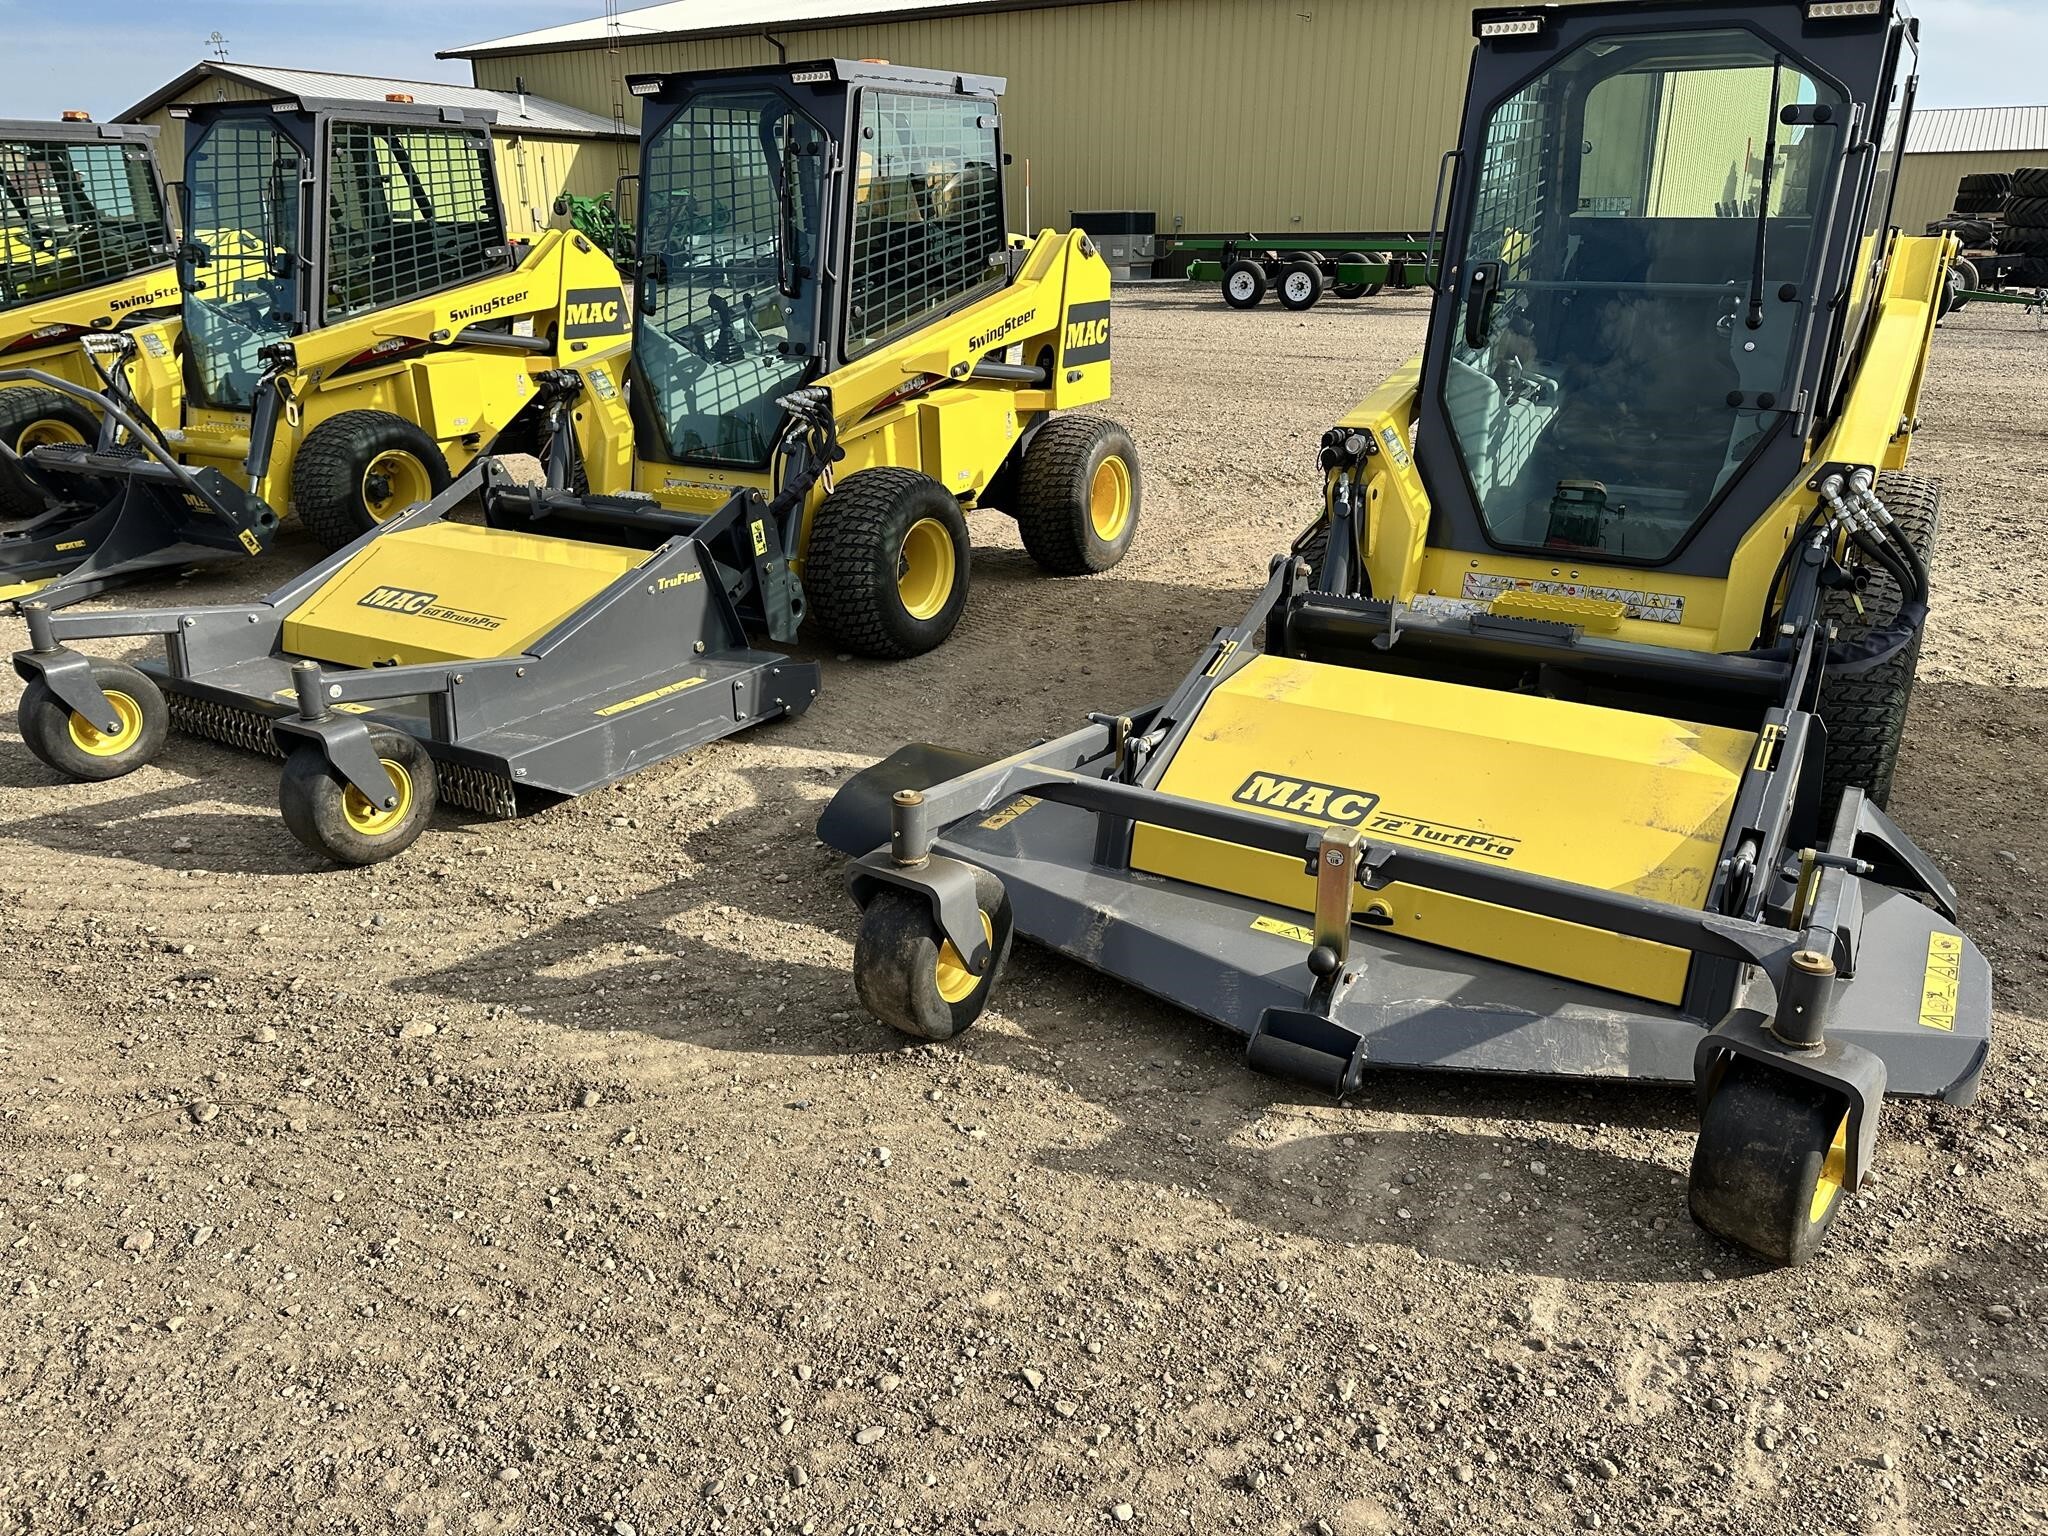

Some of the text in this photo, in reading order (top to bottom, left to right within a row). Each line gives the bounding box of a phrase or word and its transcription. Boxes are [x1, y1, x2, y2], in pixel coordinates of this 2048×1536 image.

[110, 287, 180, 312] SwingSte
[450, 290, 529, 323] SwingSteer
[566, 301, 618, 326] MAC
[969, 308, 1036, 352] SwingSteer
[1065, 318, 1110, 350] MAC
[657, 571, 701, 590] TruFlex
[361, 588, 434, 612] MAC
[441, 610, 501, 629] BrushPro
[1238, 775, 1373, 820] MAC
[1370, 816, 1515, 857] 72" TurfPro
